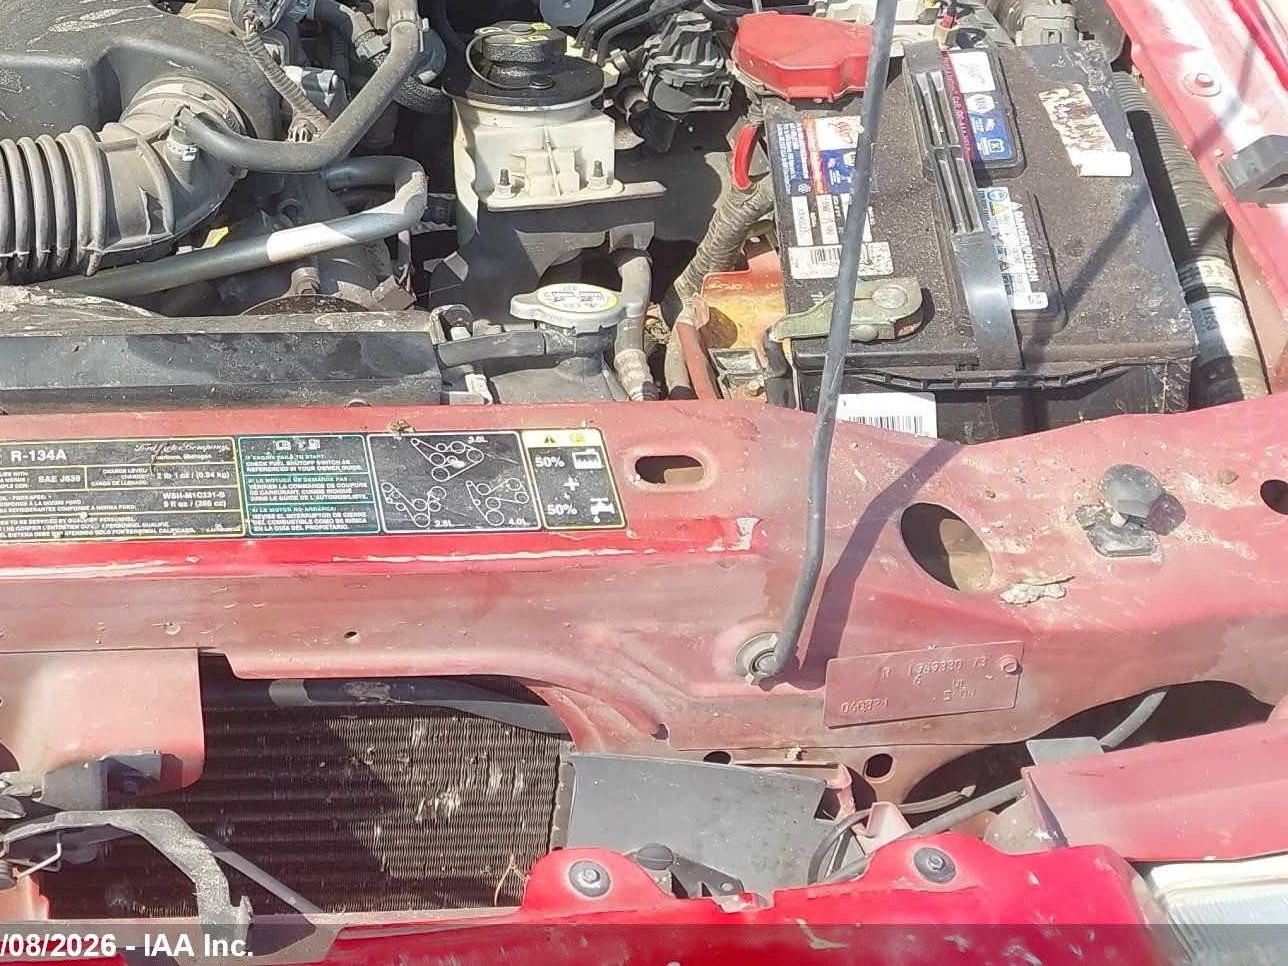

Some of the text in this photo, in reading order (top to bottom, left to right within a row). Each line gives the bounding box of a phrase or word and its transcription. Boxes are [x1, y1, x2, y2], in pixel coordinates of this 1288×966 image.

[468, 436, 488, 444] 3.0L
[10, 449, 68, 462] R-134A
[534, 456, 565, 468] 50%
[59, 474, 81, 482] J639
[547, 505, 578, 516] 50%
[508, 518, 529, 526] 4.0L
[882, 667, 893, 680] R
